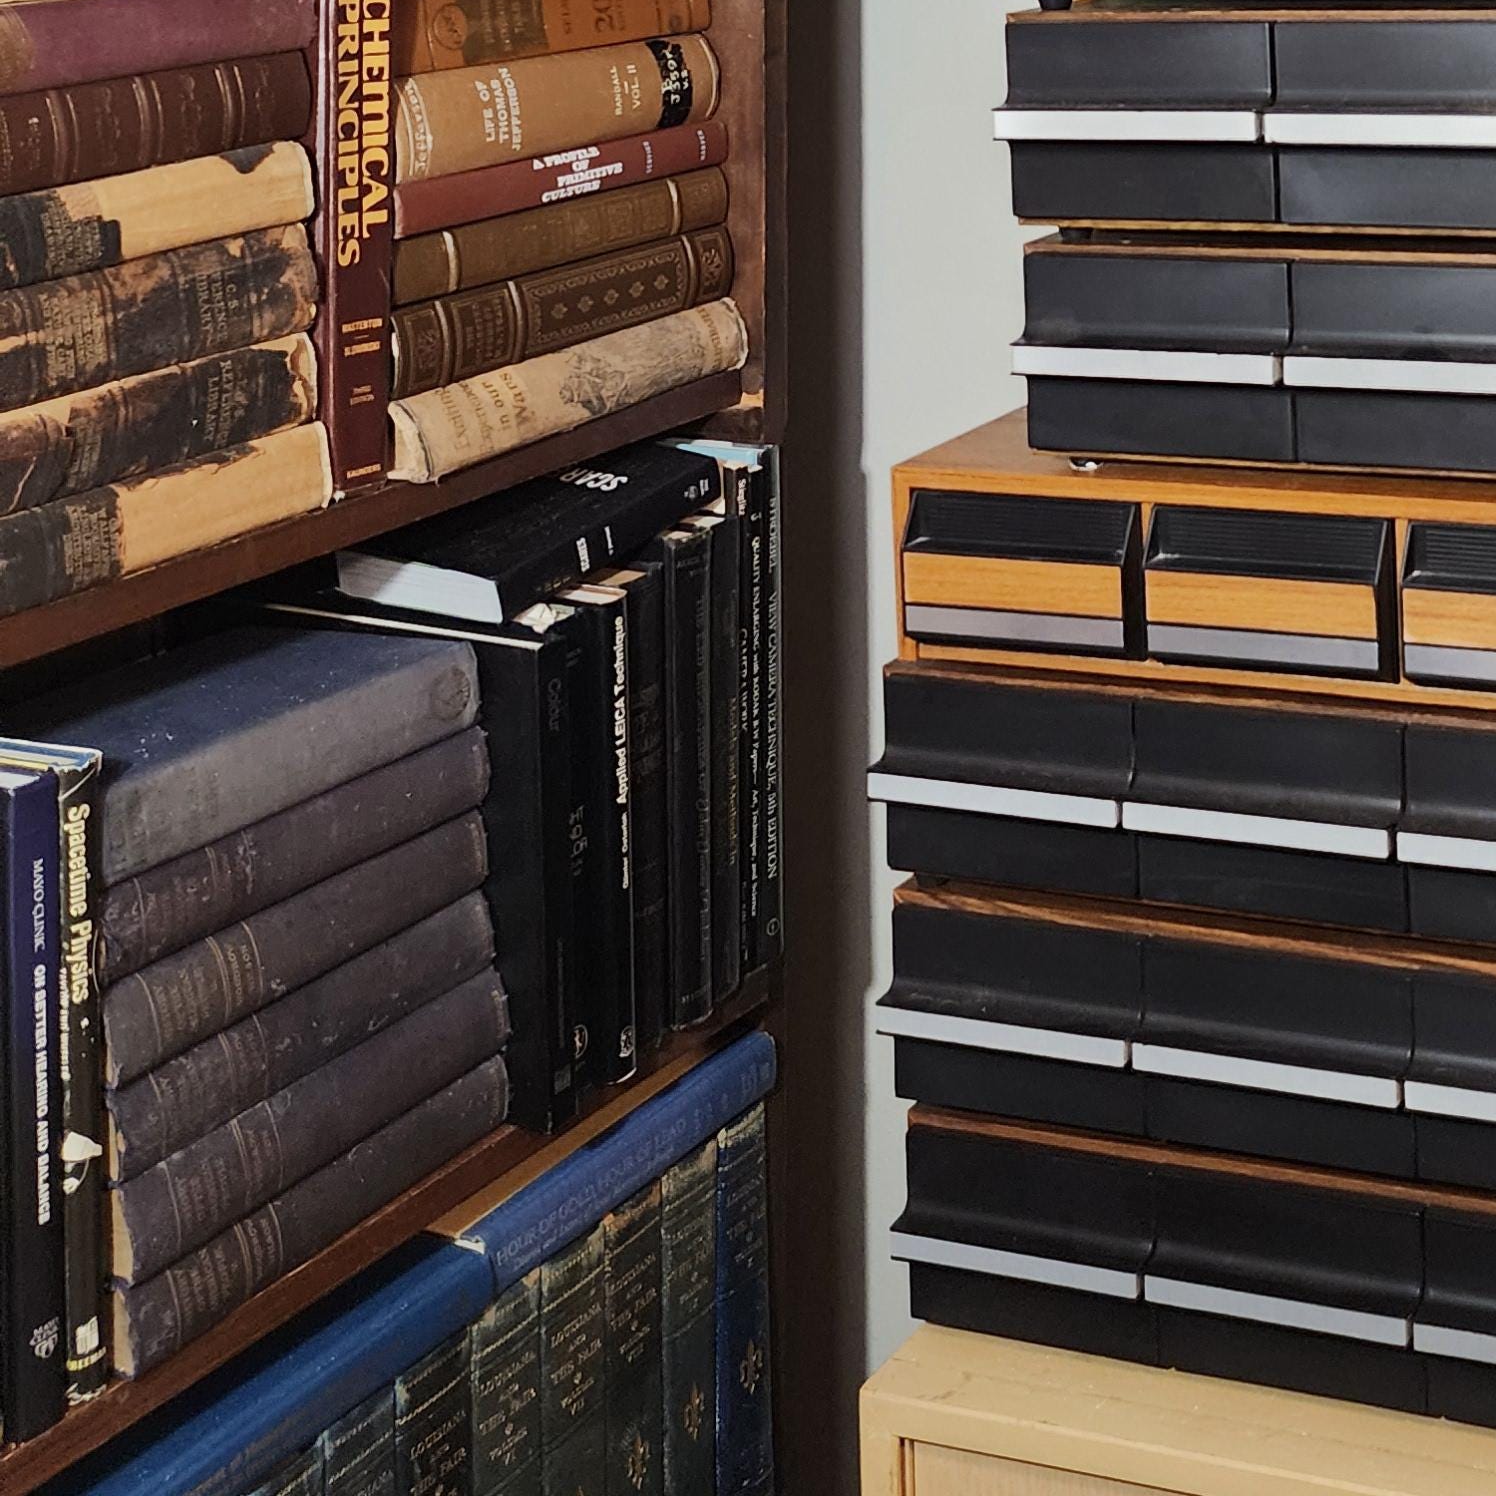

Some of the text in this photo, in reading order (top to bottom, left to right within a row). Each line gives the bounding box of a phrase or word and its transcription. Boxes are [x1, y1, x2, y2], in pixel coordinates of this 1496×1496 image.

[475, 80, 495, 142] LIFE OF
[490, 79, 509, 144] THOMAS
[498, 67, 522, 151] JEFFERSON
[609, 65, 623, 116] RANDALL
[545, 146, 600, 168] PROFILE
[557, 162, 623, 188] PRIMITIVE
[572, 159, 589, 172] OF
[542, 180, 601, 204] CULTURE
[481, 381, 505, 408] our
[501, 373, 528, 431] Wars
[768, 592, 778, 628] VIEW
[613, 615, 629, 804] Applied LEICA Technique
[768, 817, 777, 879] EDITION
[63, 803, 93, 1004] Spacetime Physics
[32, 858, 50, 1225] MAYO CLINIC ON BETTER HEARING AND BALANCE
